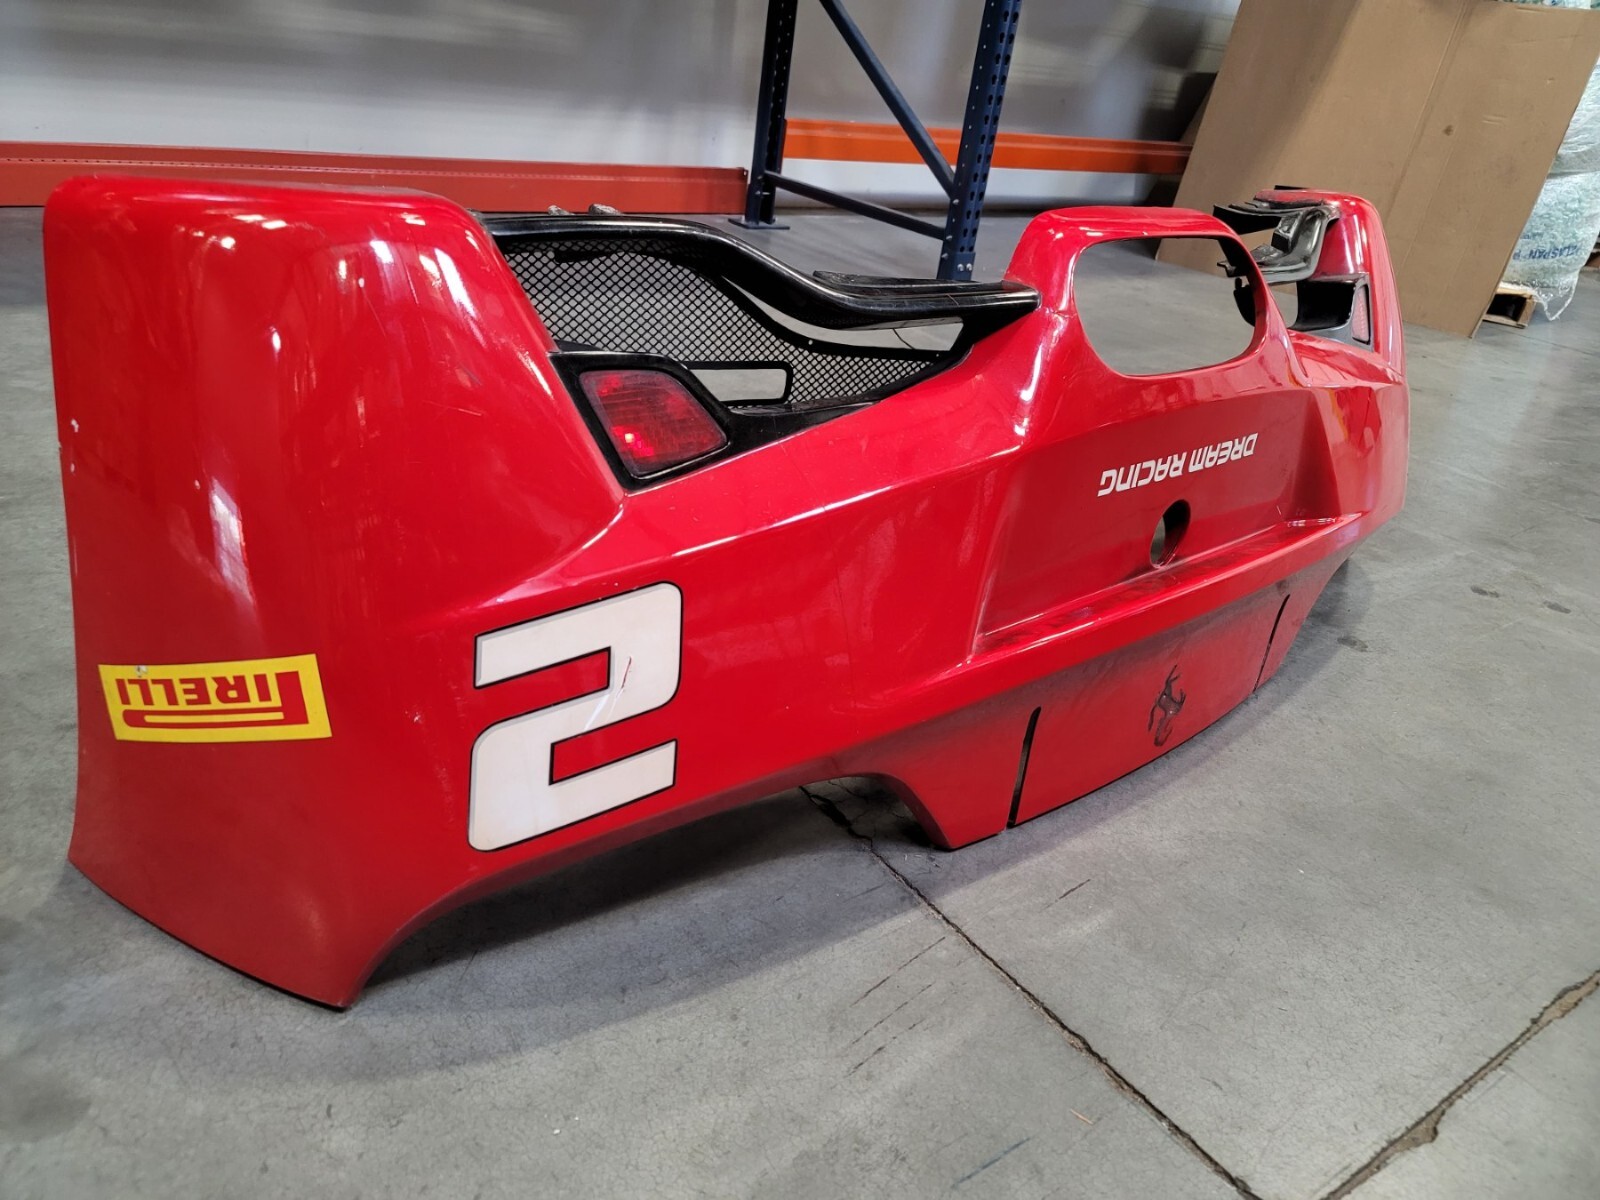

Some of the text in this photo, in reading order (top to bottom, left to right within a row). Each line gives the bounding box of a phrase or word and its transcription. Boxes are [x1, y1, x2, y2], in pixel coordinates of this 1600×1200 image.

[1097, 433, 1258, 497] DREAM RACING
[115, 671, 309, 729] PIRELLI
[468, 581, 683, 852] 2
